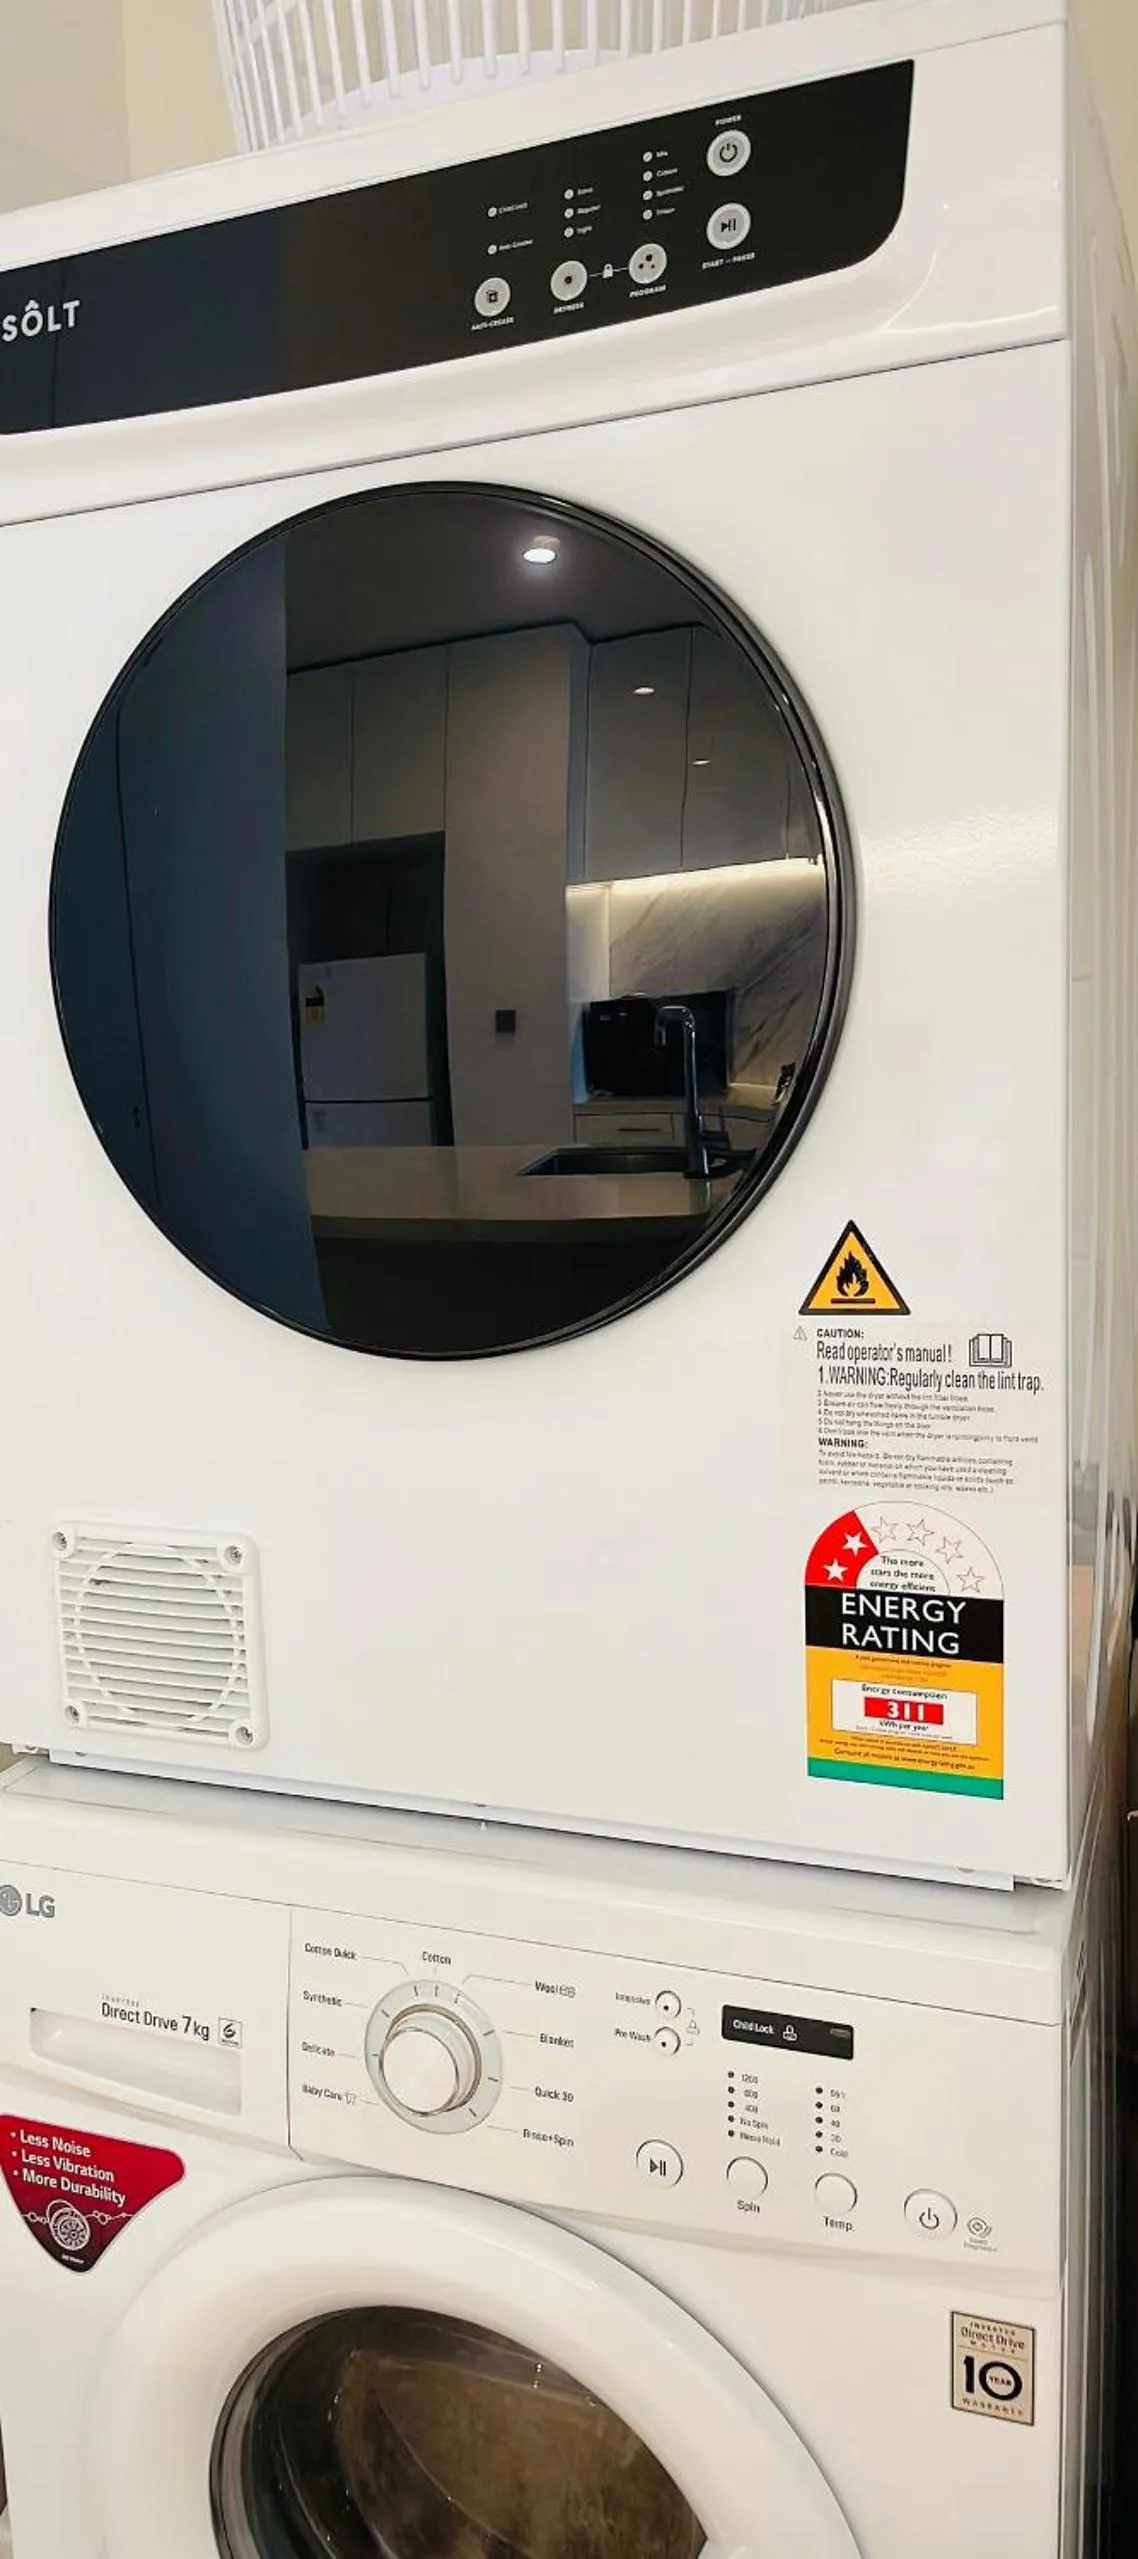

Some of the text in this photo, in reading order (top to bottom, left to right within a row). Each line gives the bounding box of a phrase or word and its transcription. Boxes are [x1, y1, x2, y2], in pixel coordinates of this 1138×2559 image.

[2, 299, 81, 342] SÔLT
[816, 1328, 865, 1339] CAUTION:
[816, 1340, 846, 1361] Read
[847, 1343, 903, 1365] operator's
[945, 1369, 975, 1389] clean
[978, 1371, 995, 1390] the
[998, 1371, 1016, 1391] lint
[1018, 1373, 1044, 1396] trap.
[818, 1437, 869, 1450] WARNING:
[880, 1555, 924, 1567] The more
[870, 1568, 935, 1581] stars the more
[869, 1581, 898, 1591] energy
[841, 1592, 967, 1625] ENERGY
[842, 1622, 961, 1656] RATING
[861, 1683, 948, 1700] Energy consumption
[887, 1701, 925, 1721] 311
[899, 1723, 912, 1731] per
[26, 1893, 55, 1918] LG
[304, 1942, 357, 1960] Cotton Quick
[422, 1950, 452, 1965] Cotton
[303, 1989, 342, 2007] Synthetic
[101, 2002, 140, 2024] Direct
[144, 2010, 178, 2031] Drive
[733, 2019, 774, 2035] Child Lock
[540, 2032, 574, 2049] Blanket
[535, 2086, 560, 2101] Quick
[20, 2129, 91, 2158] Less Noise
[21, 2149, 115, 2182] Less Vibration
[22, 2168, 126, 2208] More Durability
[737, 2199, 761, 2215] Spin
[823, 2214, 856, 2232] Temp.
[961, 2326, 1025, 2350] Direct Drive
